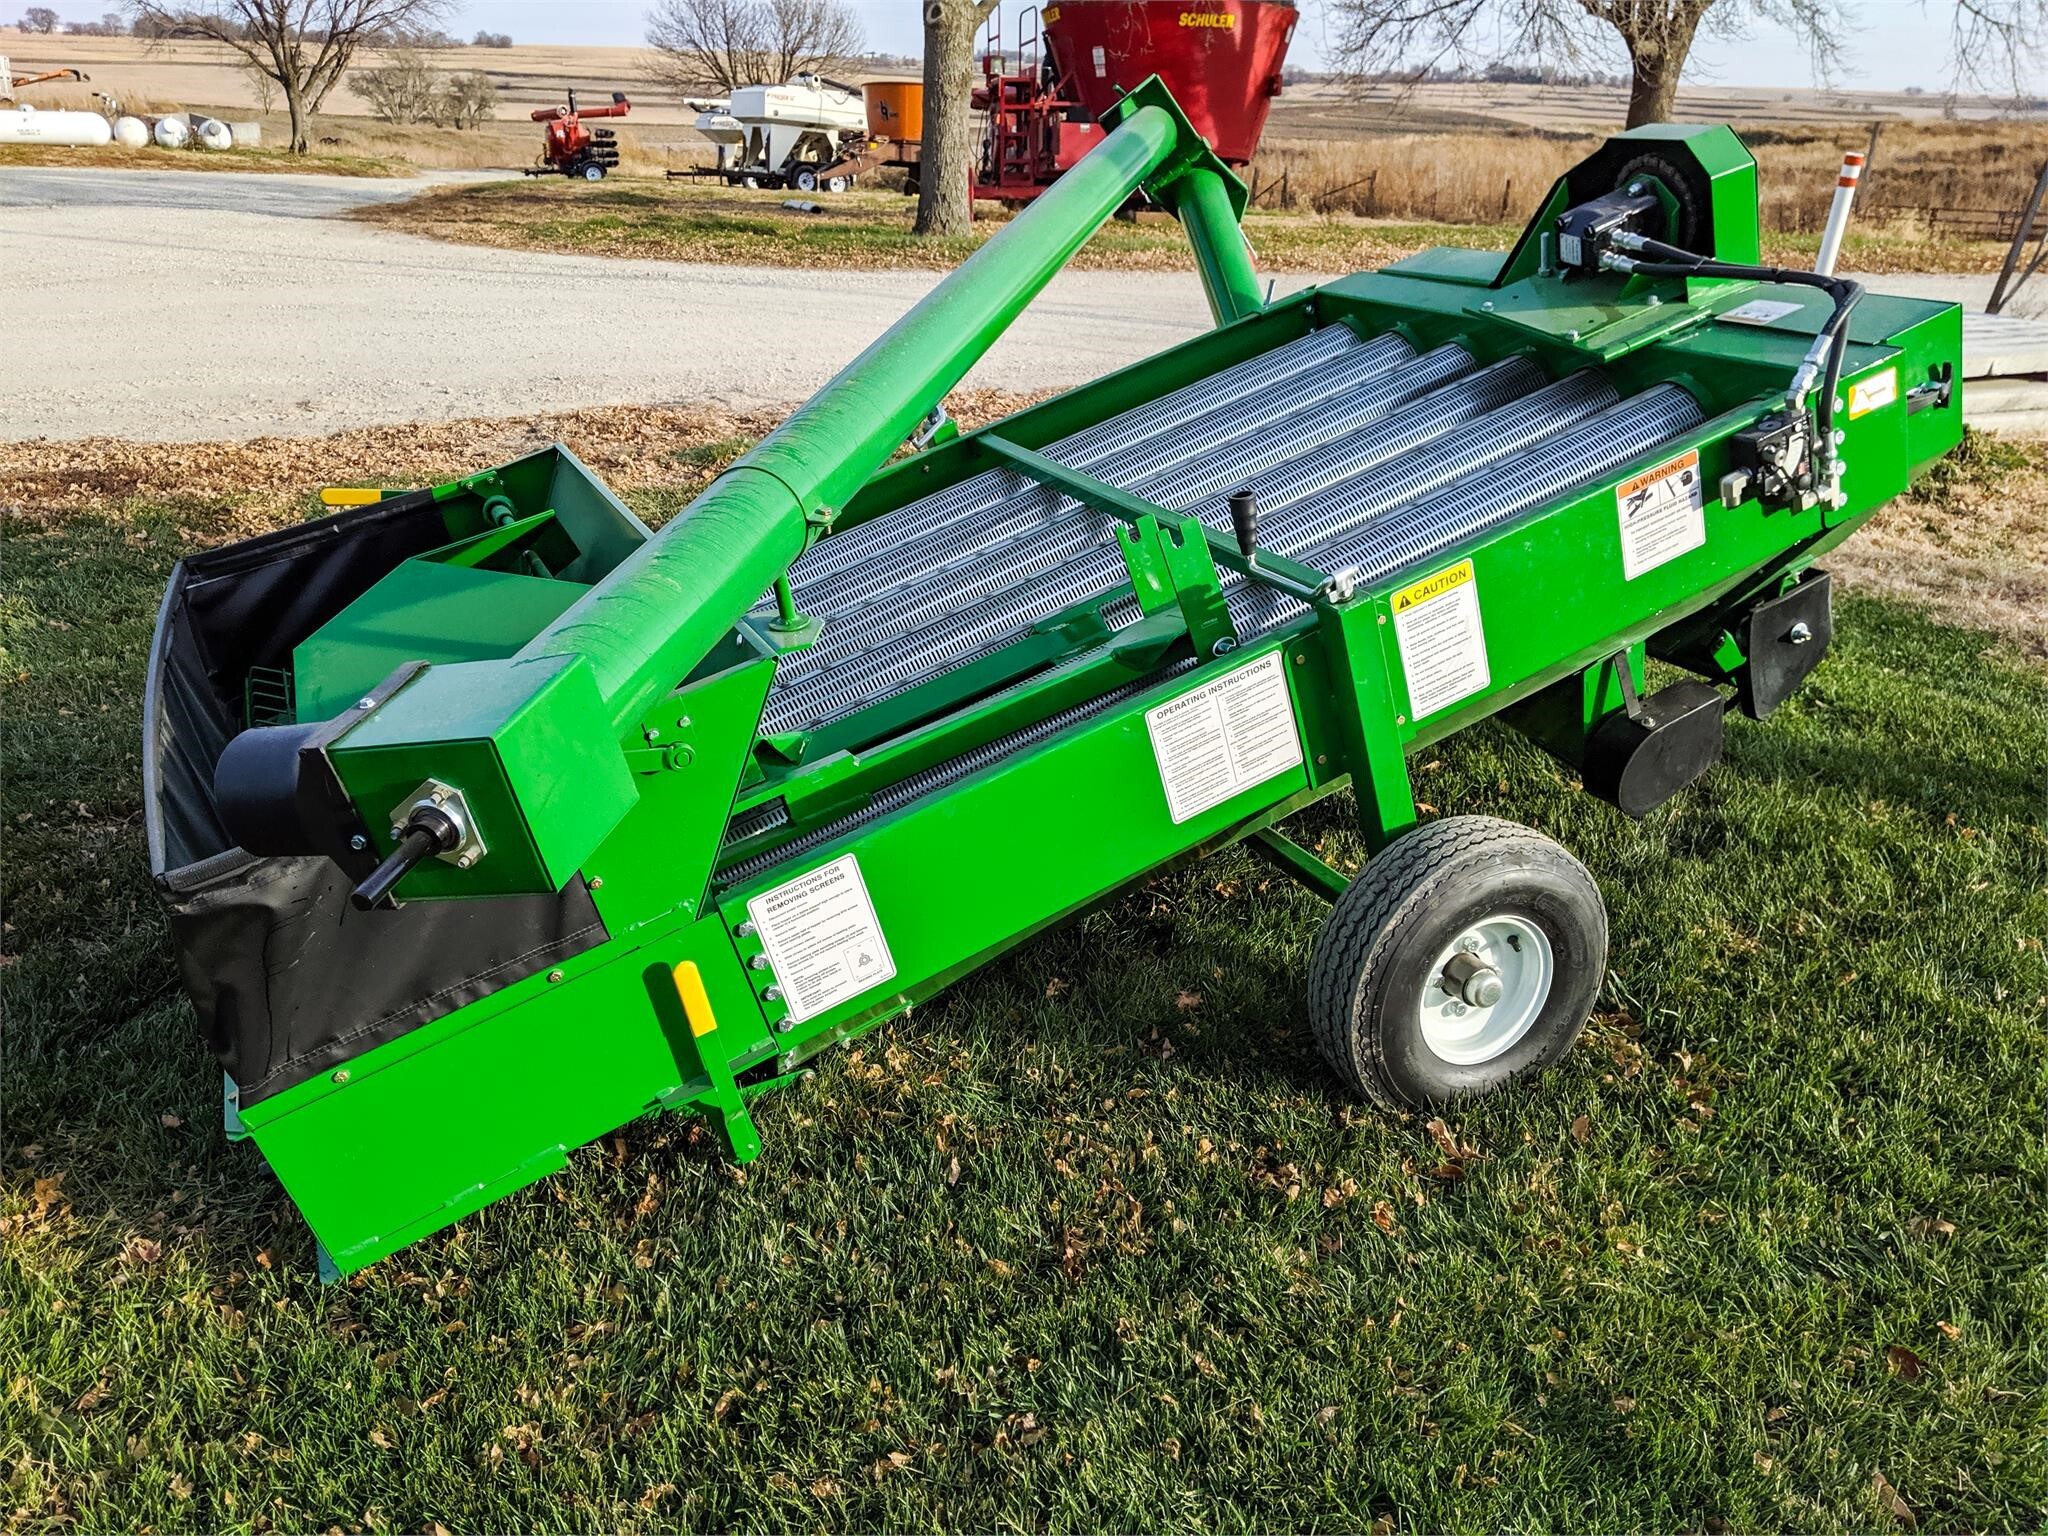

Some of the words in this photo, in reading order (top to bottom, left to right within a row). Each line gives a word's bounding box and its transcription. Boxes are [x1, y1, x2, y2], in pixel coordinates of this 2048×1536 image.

[1179, 12, 1235, 28] SCHULER
[1640, 460, 1684, 486] WARNING
[1663, 501, 1677, 511] FLUID
[1413, 568, 1467, 601] CAUTION
[1156, 691, 1207, 720] OPERATING
[1208, 660, 1272, 695] INSTRUCTIONS
[765, 874, 823, 905] INSTRUCTIONS
[823, 865, 841, 878] FOR
[766, 892, 809, 914] REMOVING
[808, 873, 846, 894] SCREENS
